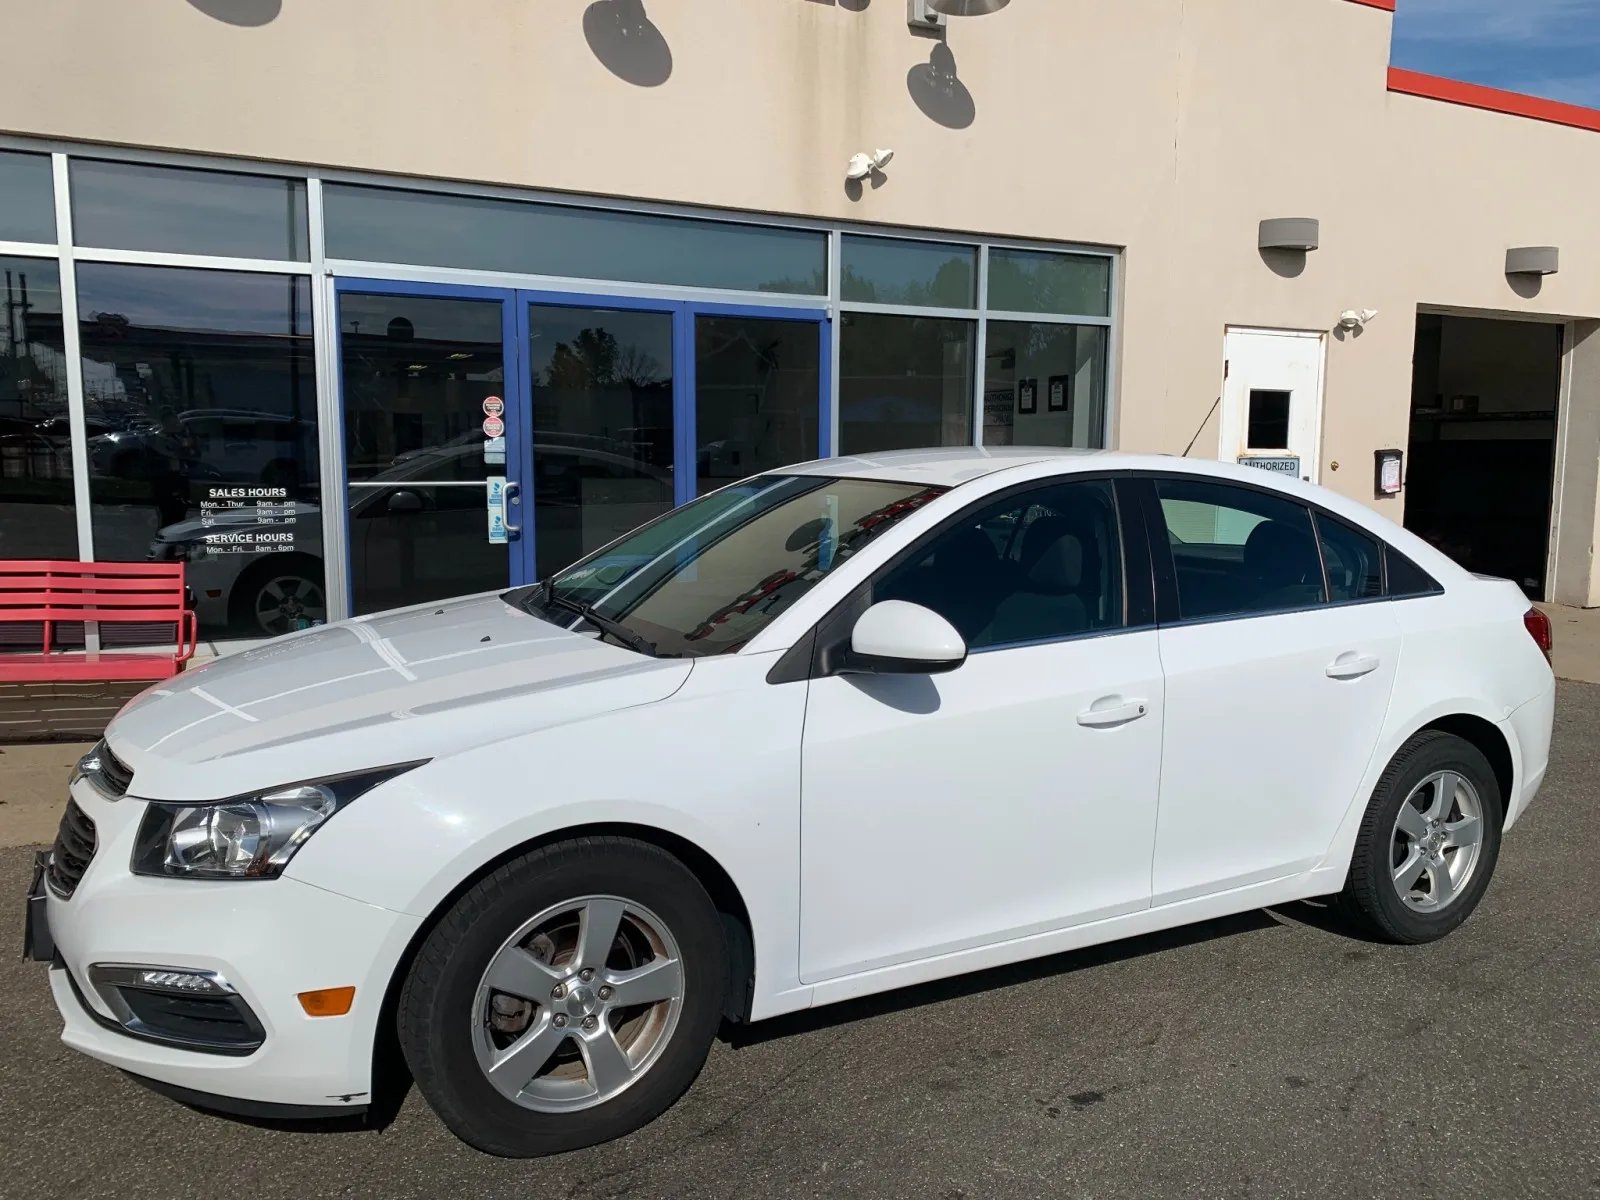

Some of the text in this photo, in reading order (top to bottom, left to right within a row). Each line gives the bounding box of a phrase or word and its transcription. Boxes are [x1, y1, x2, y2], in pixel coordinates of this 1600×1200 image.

[209, 488, 287, 497] SALES HOURS
[226, 500, 246, 508] Thur.
[201, 509, 214, 517] Fri.
[206, 533, 294, 543] SERVICE HOURS
